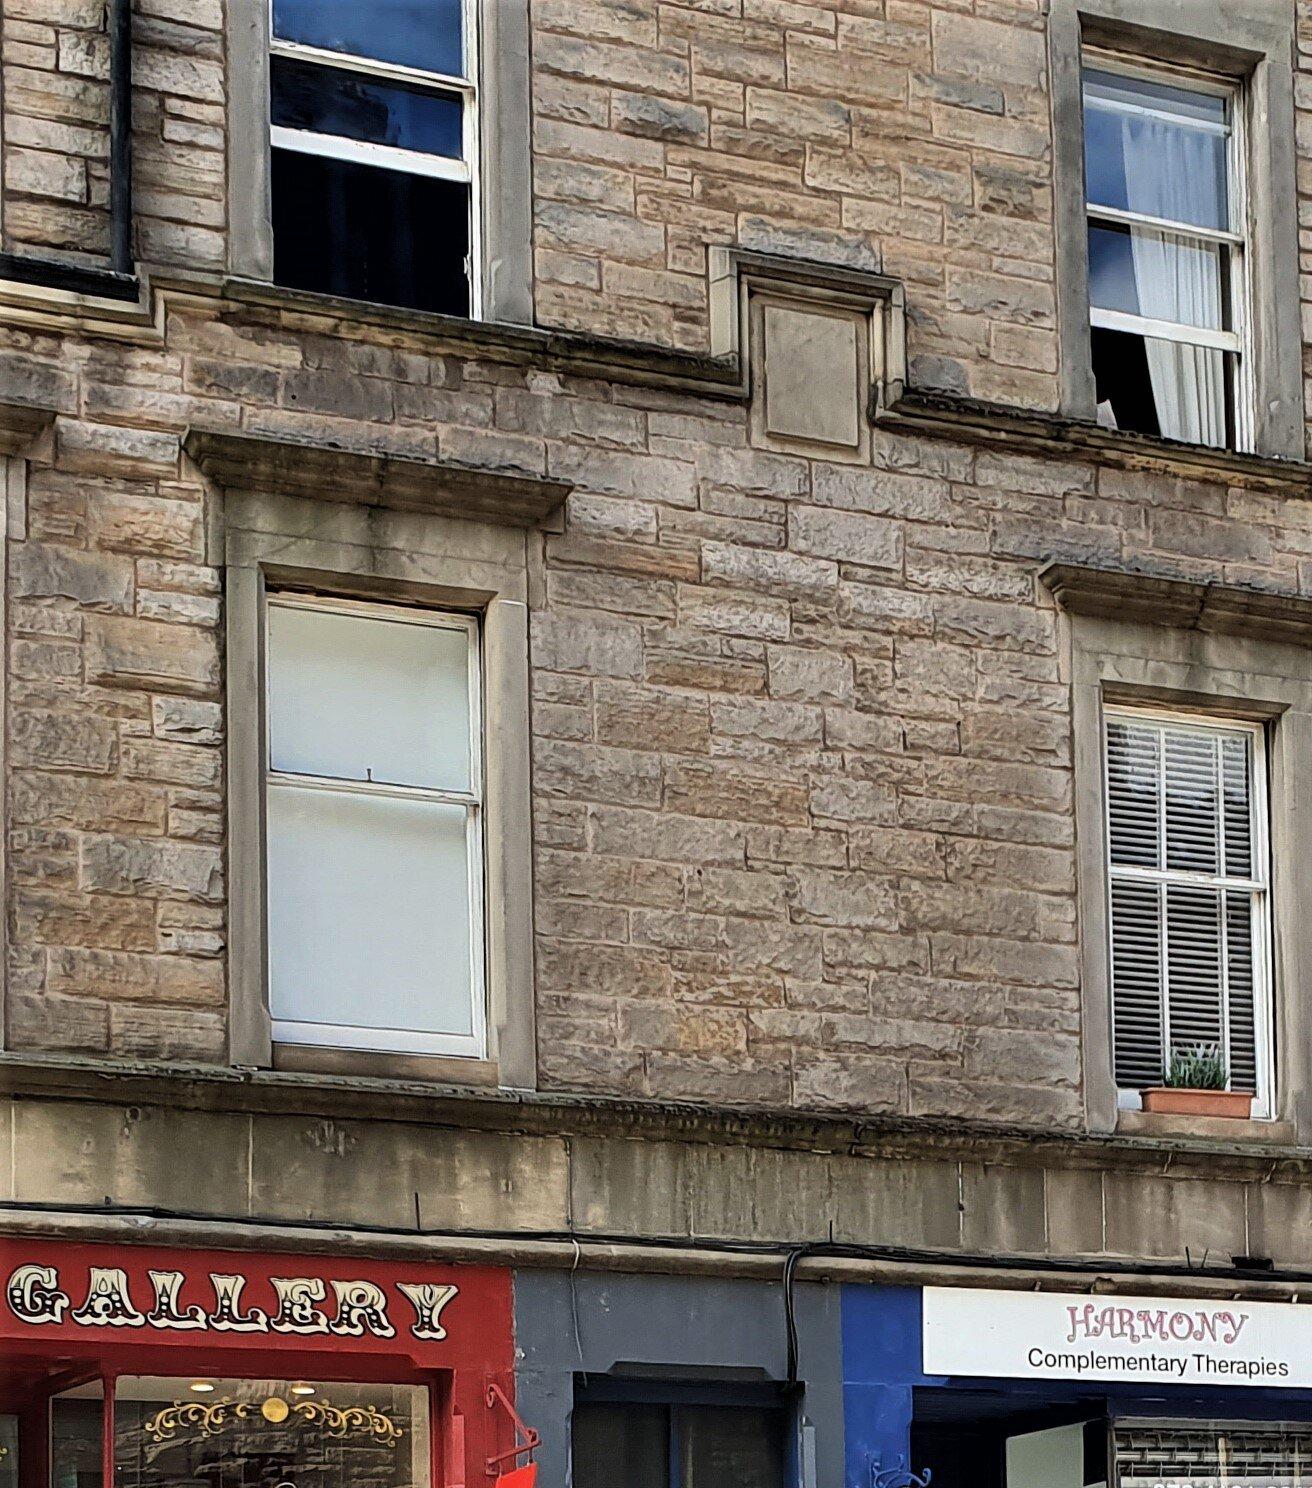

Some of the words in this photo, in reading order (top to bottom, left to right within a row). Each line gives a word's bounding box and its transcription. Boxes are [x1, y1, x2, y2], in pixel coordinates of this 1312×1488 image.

[6, 1264, 459, 1340] GALLERY
[1066, 1303, 1249, 1344] HARMONY
[1028, 1348, 1188, 1377] Complementary
[1192, 1354, 1289, 1379] Therapies
